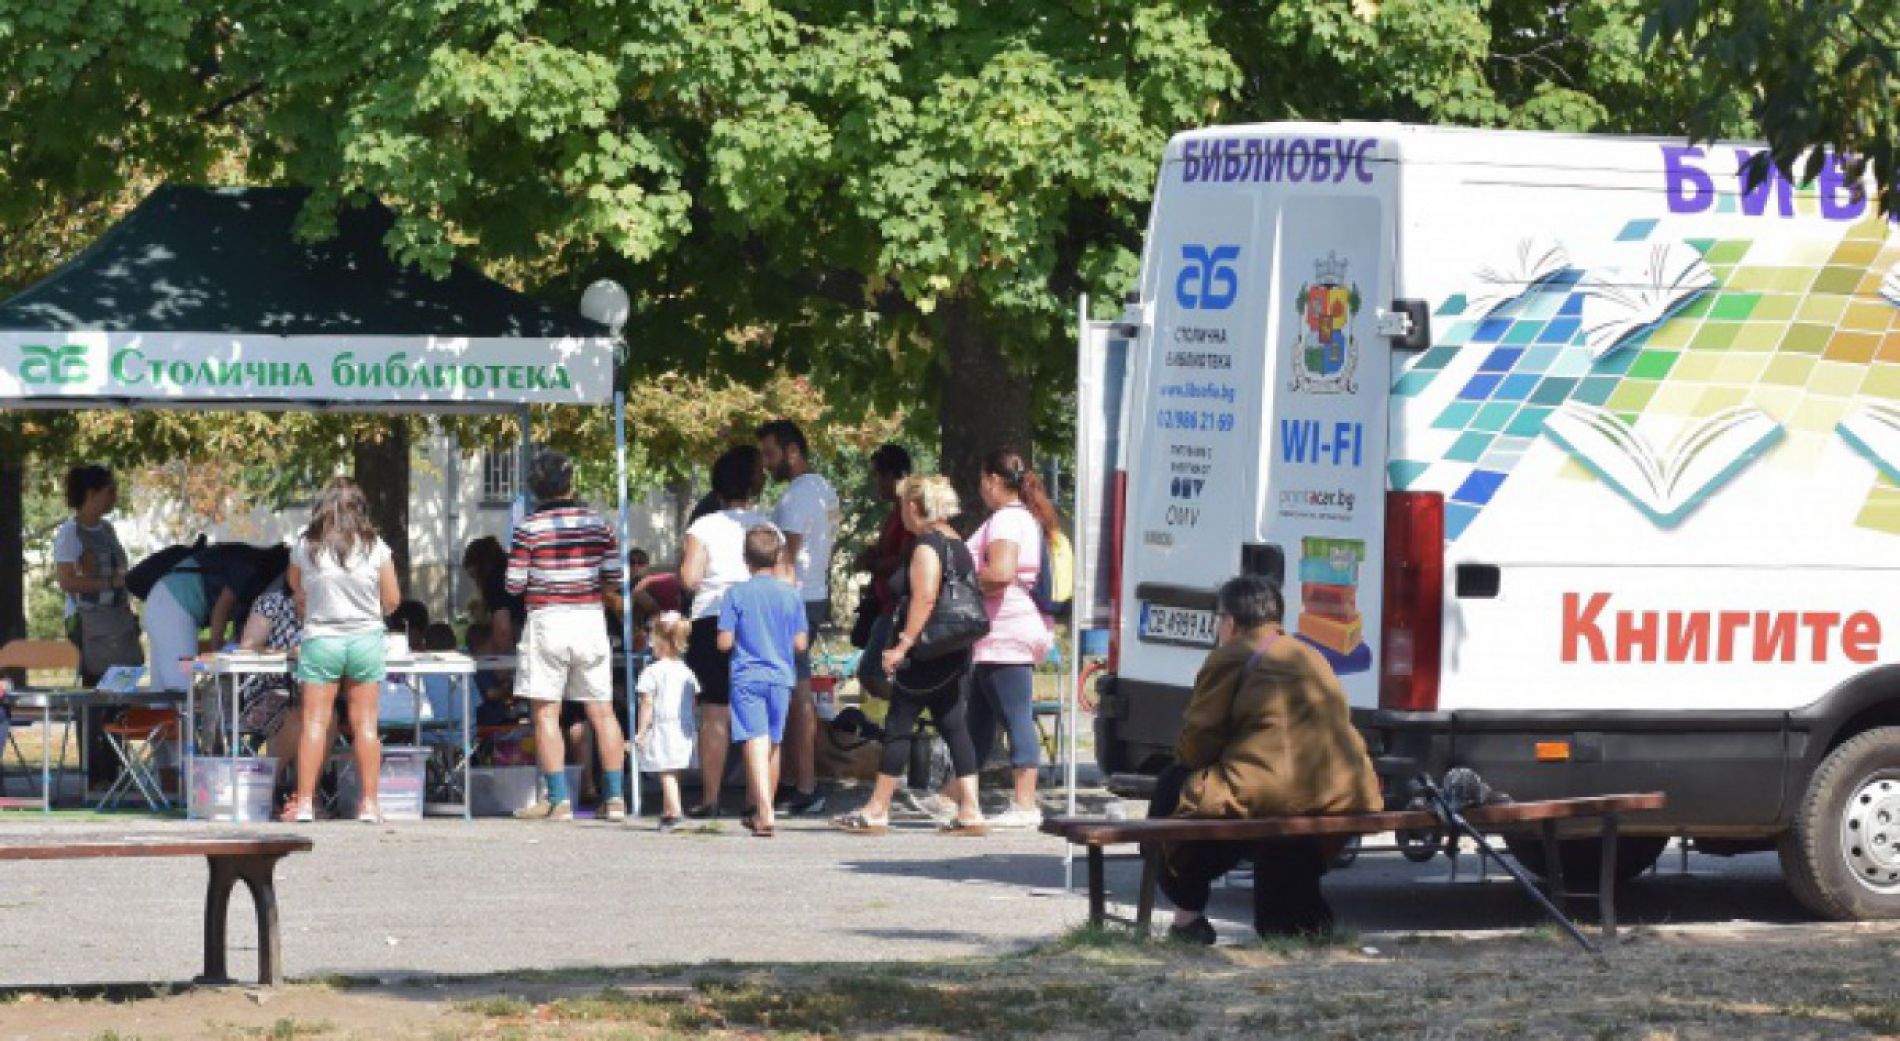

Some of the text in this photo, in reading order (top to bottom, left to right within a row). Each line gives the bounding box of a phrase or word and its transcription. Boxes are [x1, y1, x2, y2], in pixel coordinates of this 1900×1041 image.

[1182, 138, 1378, 184] БИБЛИОБУС
[1660, 145, 1900, 222] БИБ
[110, 347, 571, 390] Столична библиотека
[1280, 419, 1363, 467] WI-FI
[1560, 592, 1882, 663] Книгите
